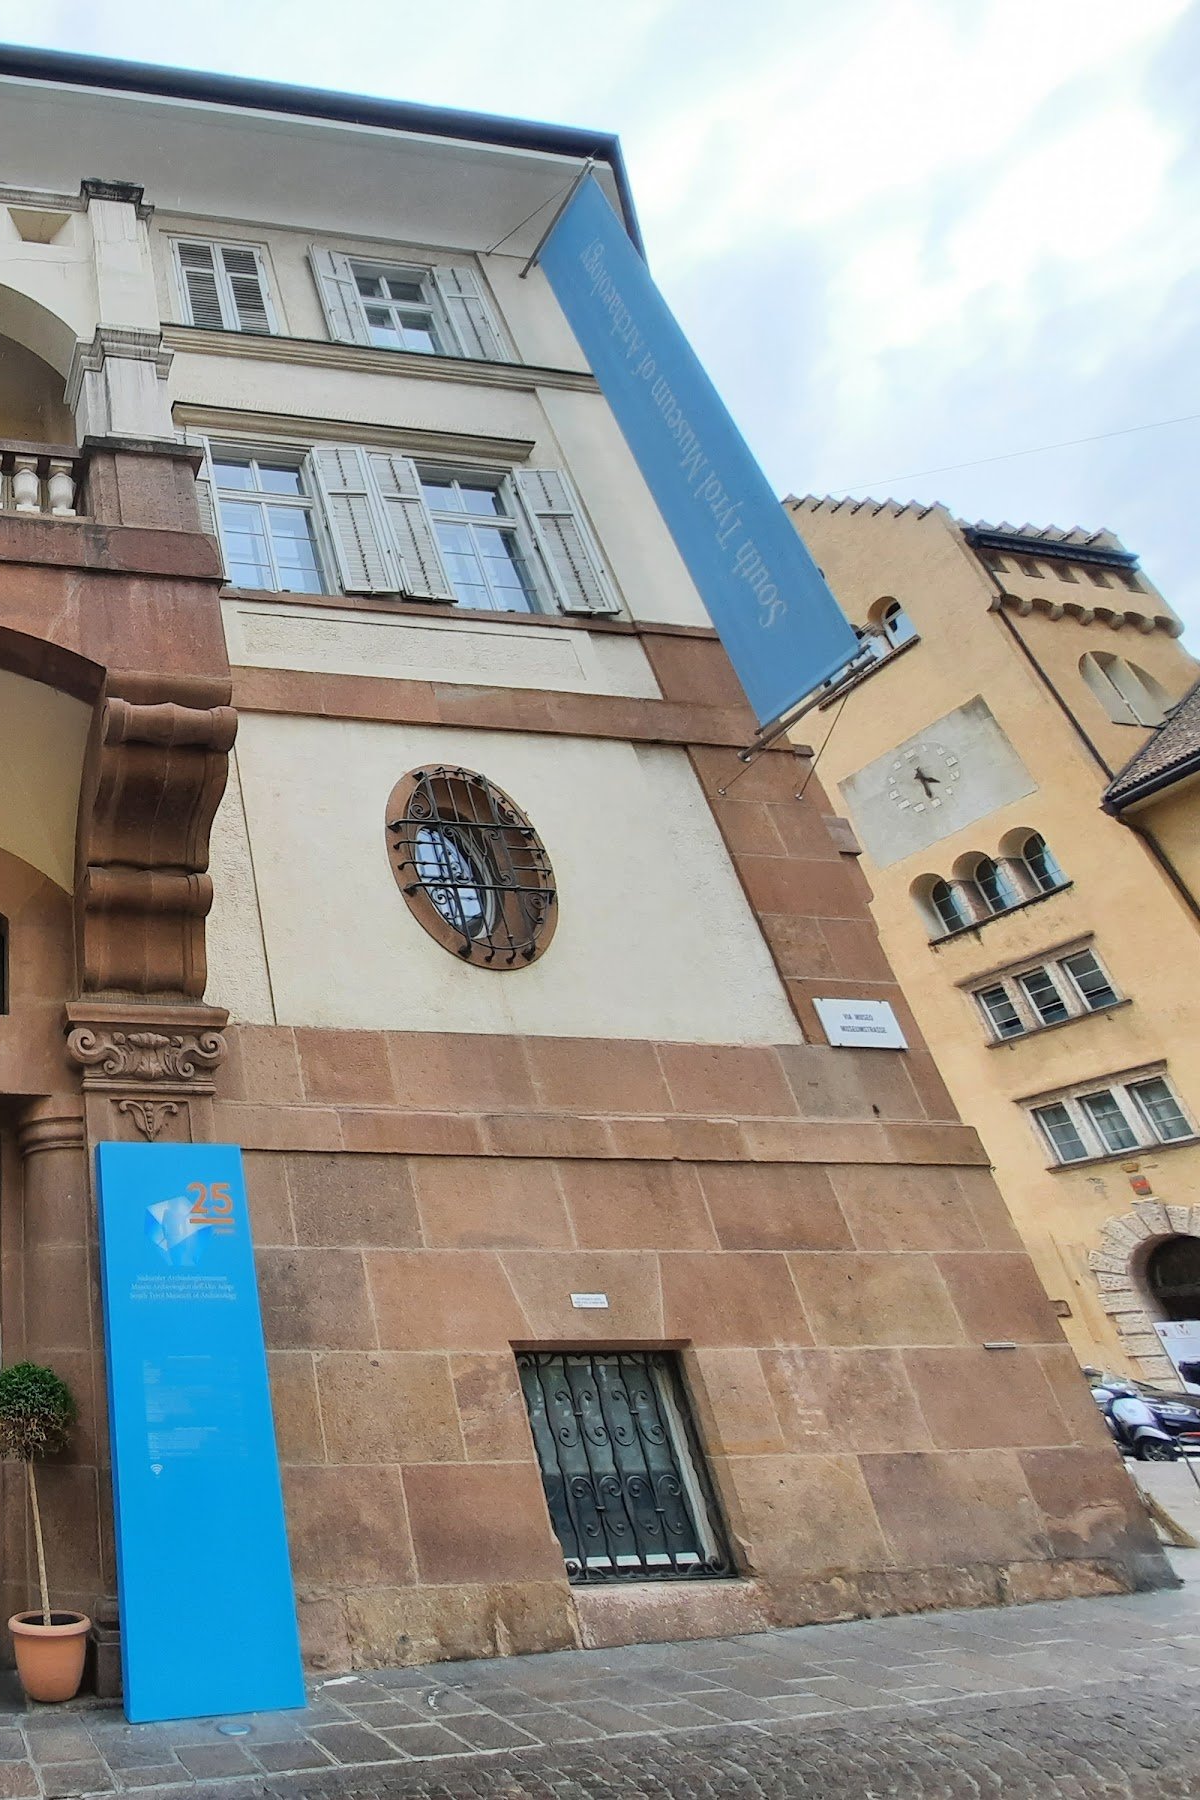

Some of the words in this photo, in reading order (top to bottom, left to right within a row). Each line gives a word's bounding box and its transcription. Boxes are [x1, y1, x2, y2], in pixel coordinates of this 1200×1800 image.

[578, 237, 641, 360] Archaeology
[630, 352, 655, 380] of
[650, 377, 707, 485] Museum
[693, 468, 743, 552] Tyrol
[732, 538, 788, 629] South
[187, 1182, 233, 1214] 25
